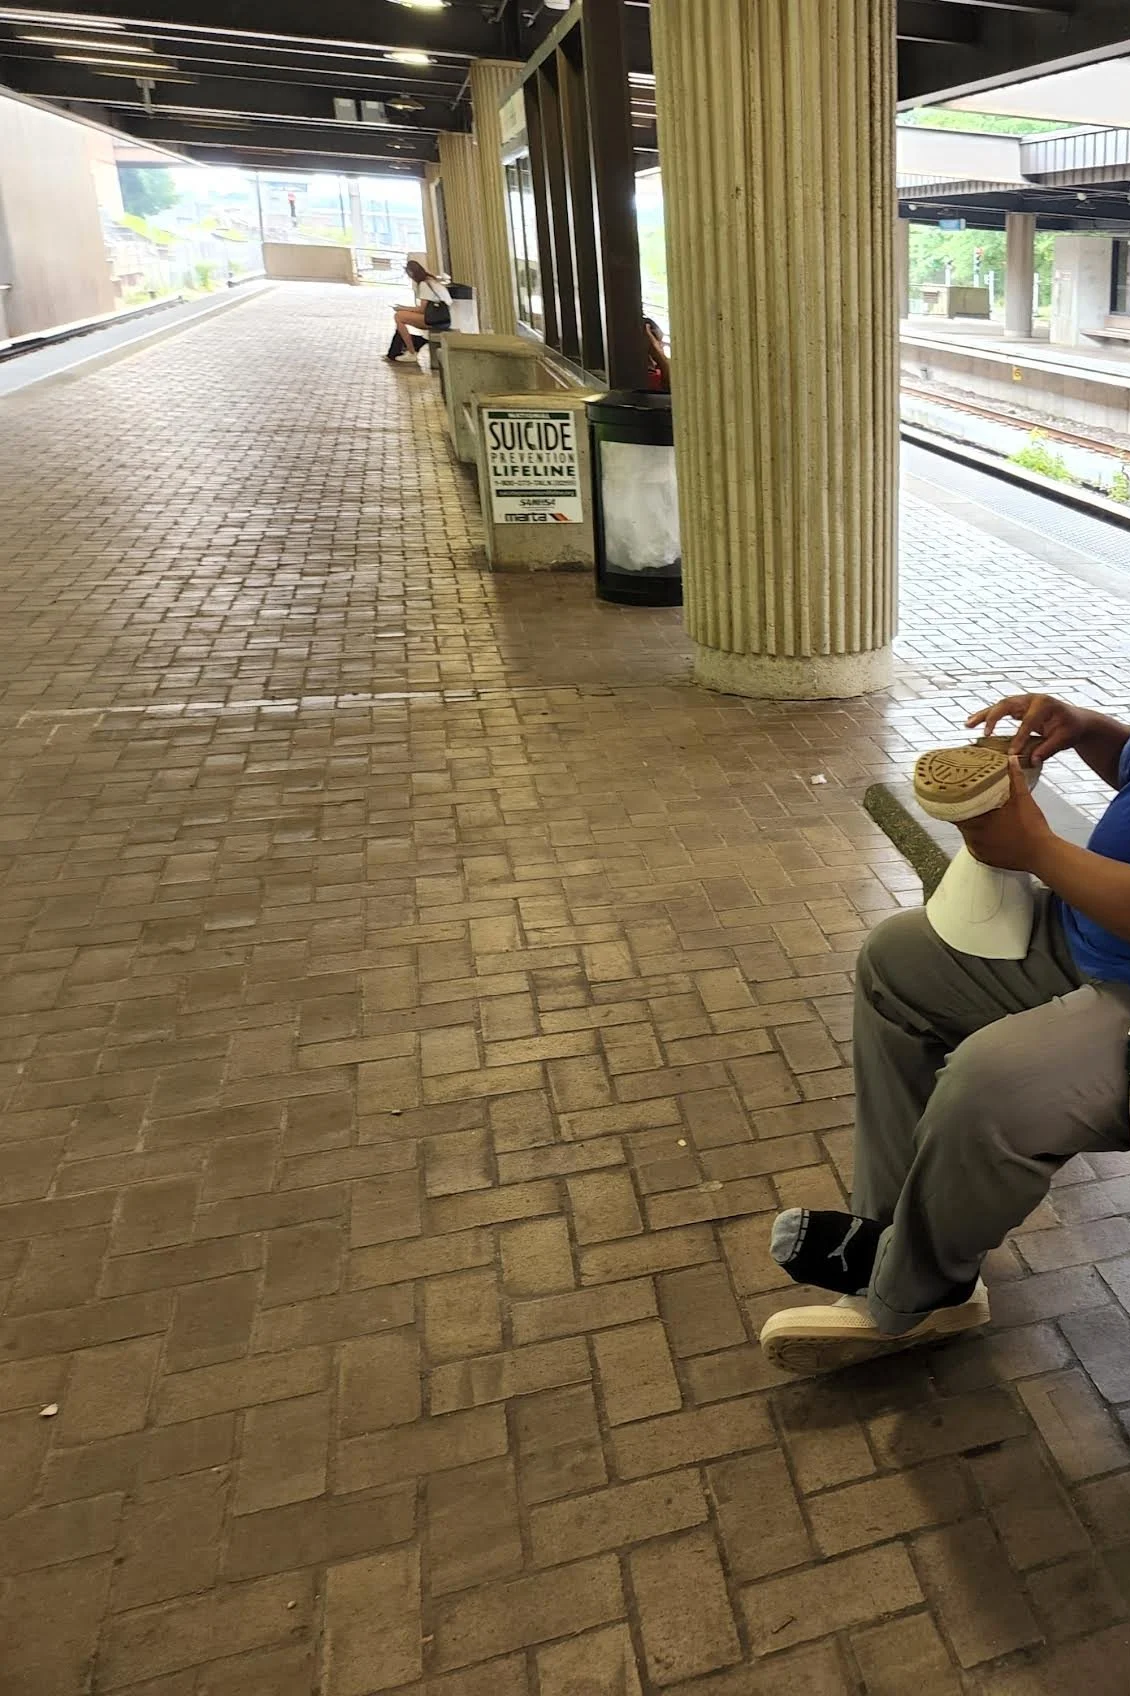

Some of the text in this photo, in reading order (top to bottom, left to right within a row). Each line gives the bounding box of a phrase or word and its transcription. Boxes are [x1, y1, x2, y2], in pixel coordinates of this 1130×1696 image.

[489, 421, 573, 451] SUICIDE
[490, 452, 575, 463] PREVENTION
[492, 465, 576, 477] LIFELINE
[504, 512, 547, 521] marta
